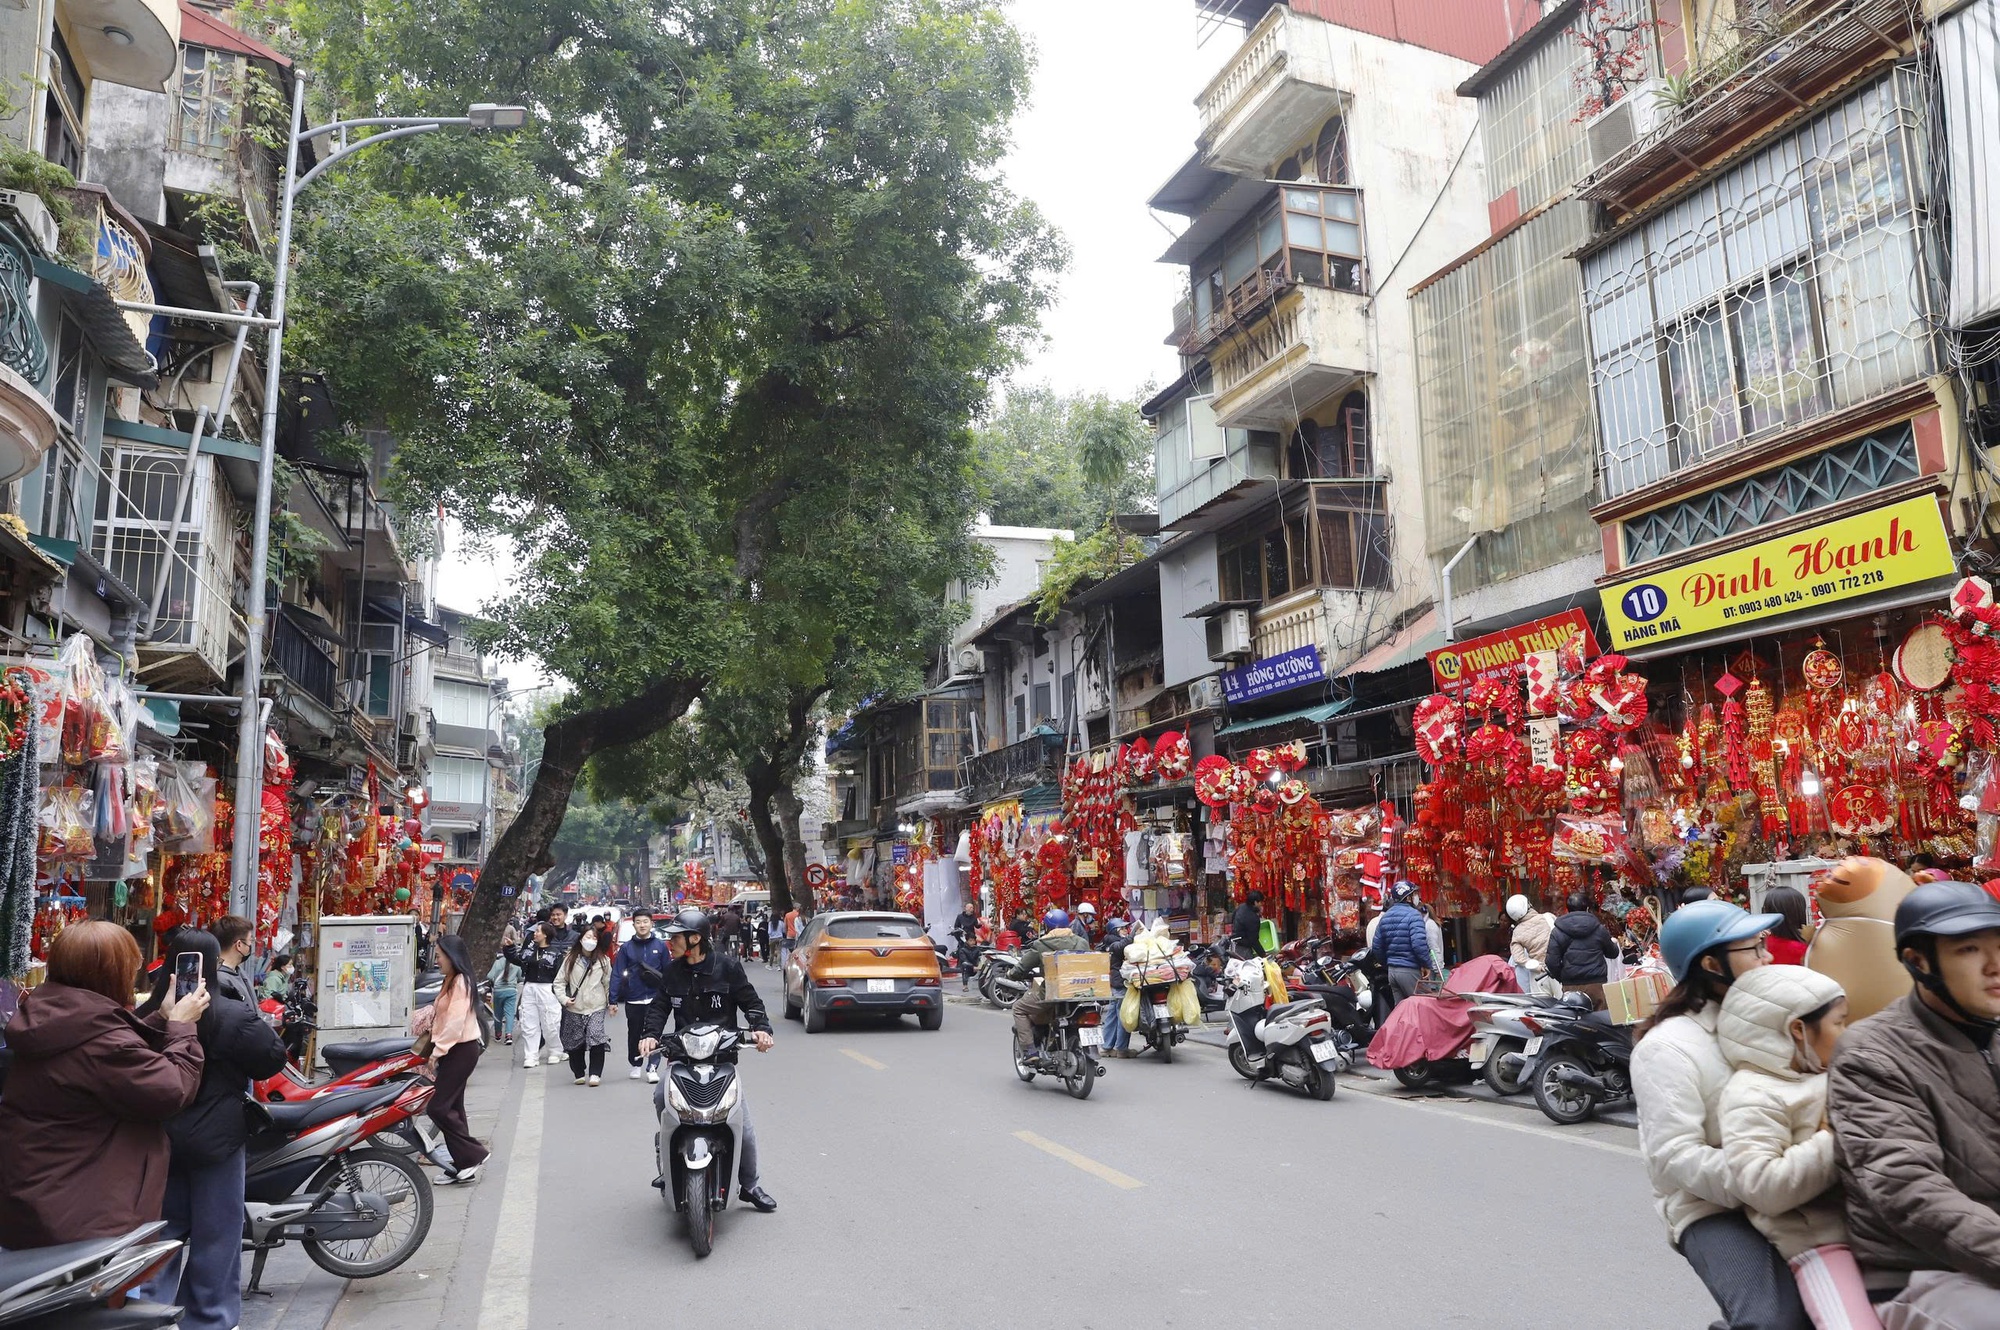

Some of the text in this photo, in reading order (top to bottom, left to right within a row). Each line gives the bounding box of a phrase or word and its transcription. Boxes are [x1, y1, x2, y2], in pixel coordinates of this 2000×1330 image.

[1787, 517, 1920, 580] Hạnh
[1628, 587, 1660, 619] 10
[1723, 606, 1738, 619] ĐT:
[1738, 599, 1762, 616] 0903
[1764, 594, 1783, 609] 480
[1784, 589, 1804, 605] 424
[1812, 581, 1838, 598] 0901
[1840, 576, 1861, 591] 772
[1862, 570, 1885, 586] 218
[1624, 615, 1682, 643] HÀNG MÃ
[1246, 655, 1314, 687] HỒNG CƯỜNG
[1438, 656, 1460, 676] 12A
[1462, 640, 1521, 672] THANH
[1223, 674, 1240, 692] 14
[504, 887, 513, 895] 19
